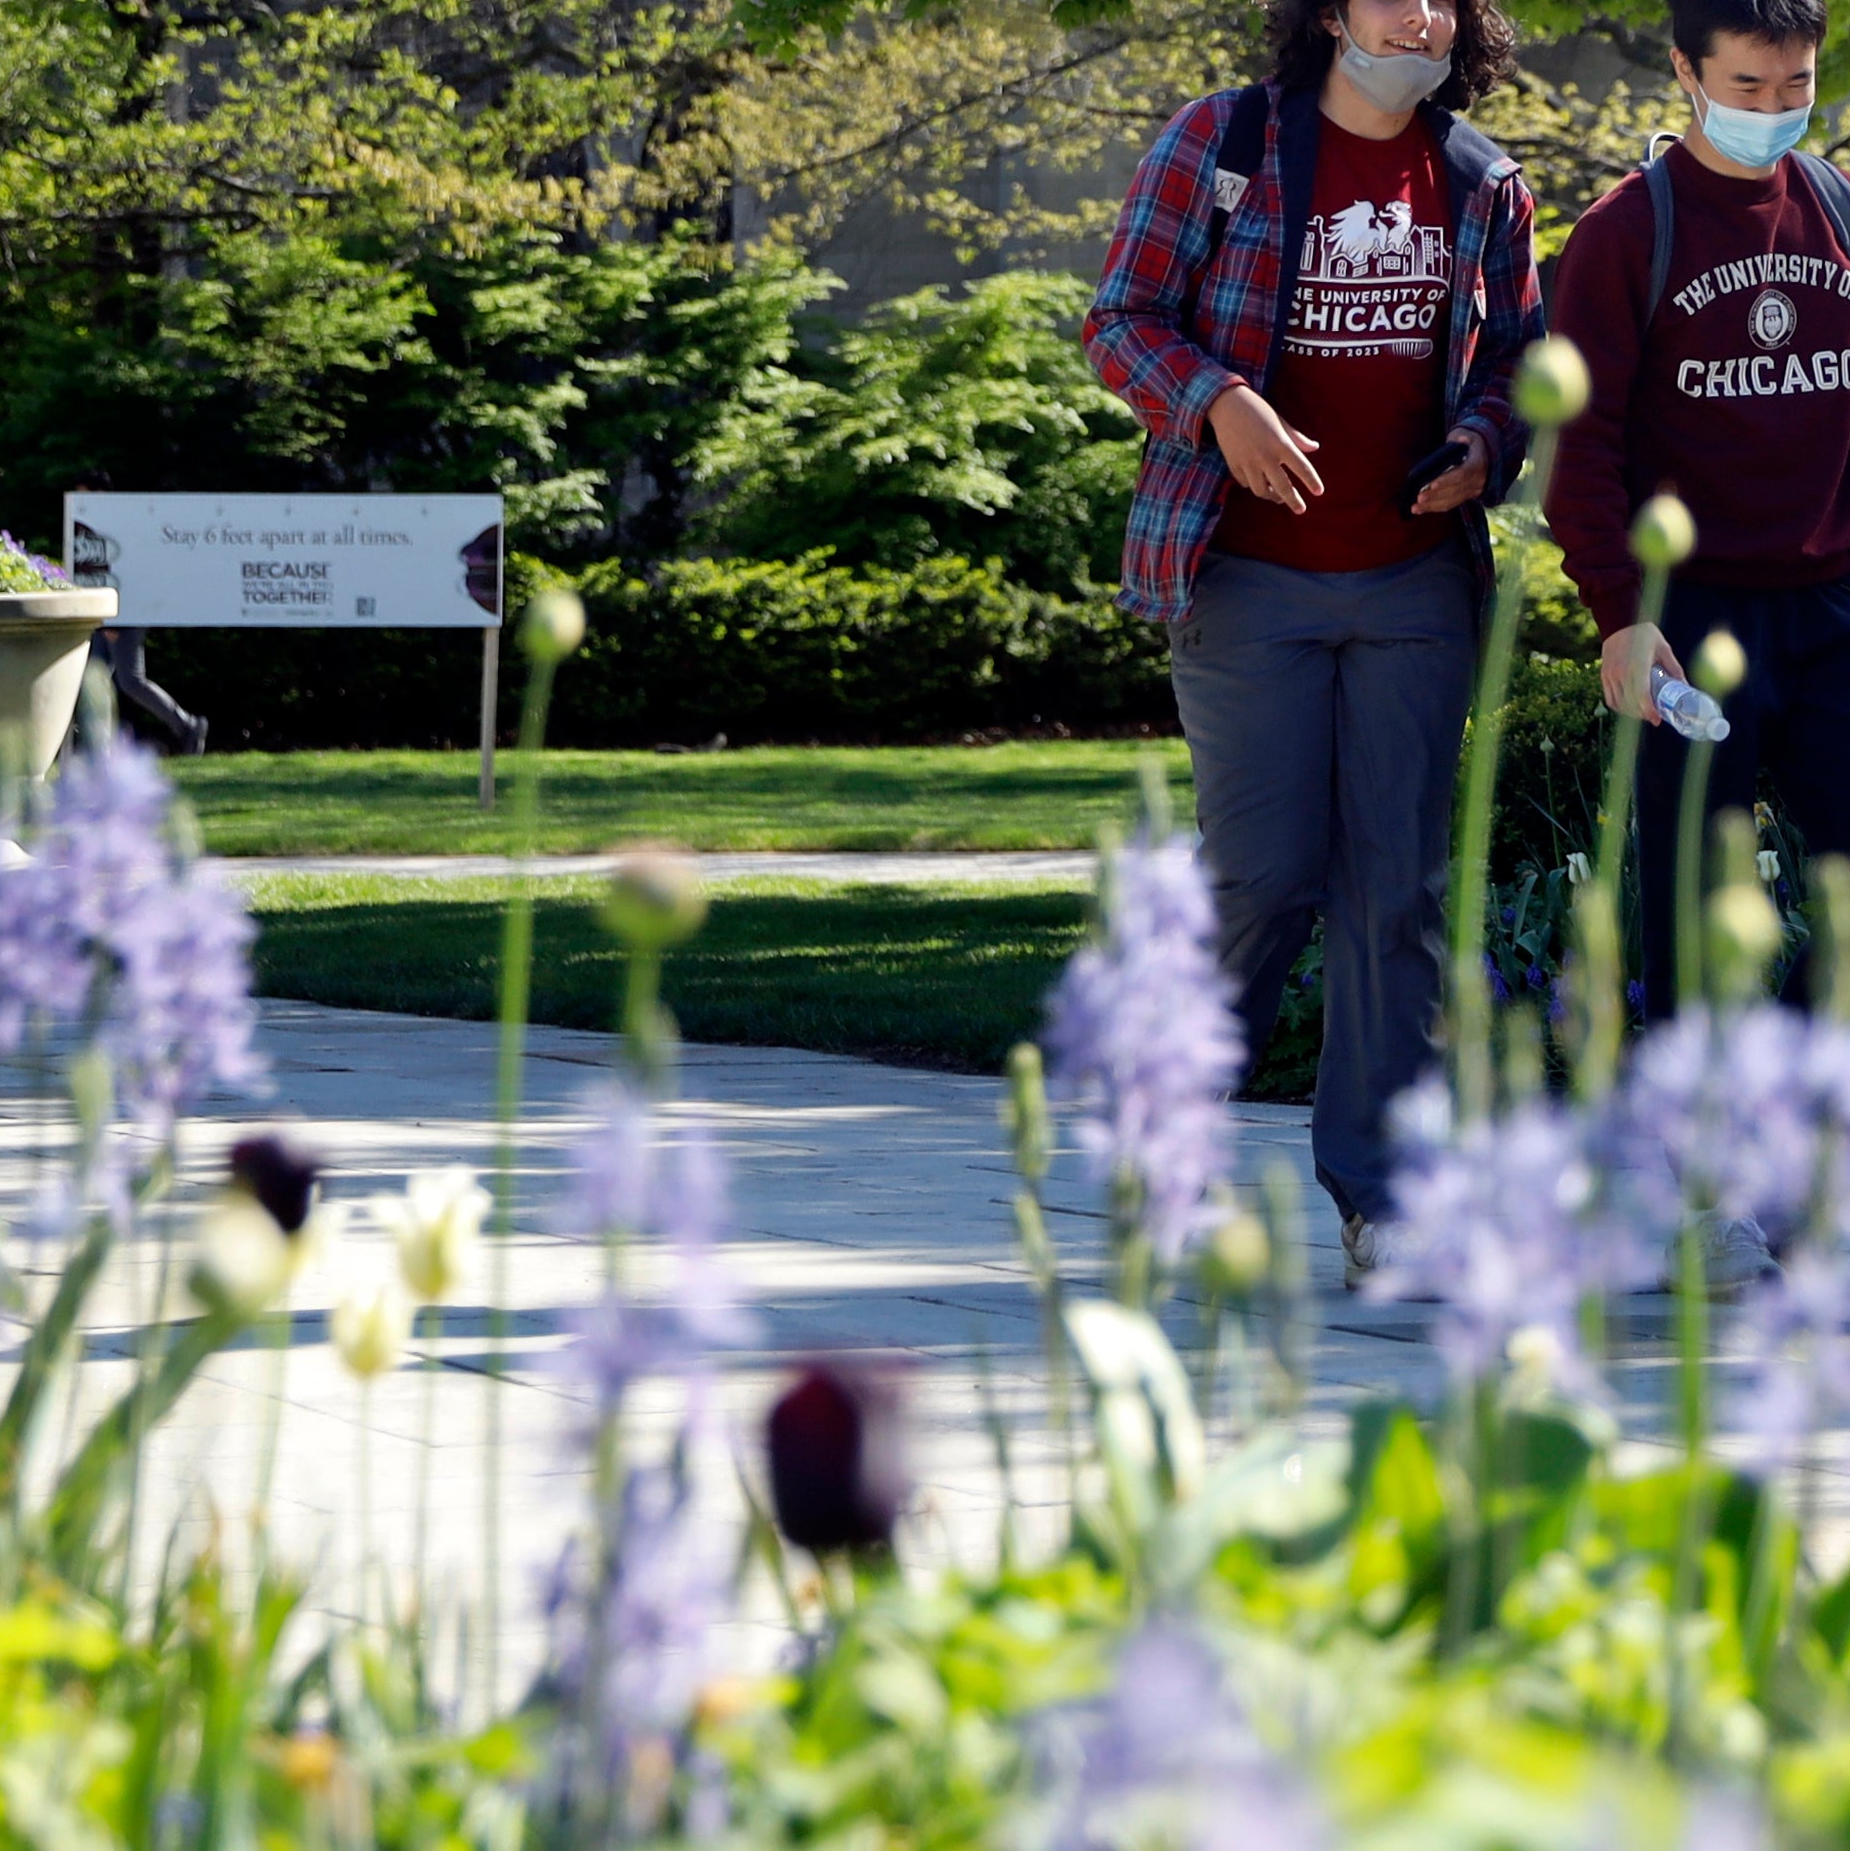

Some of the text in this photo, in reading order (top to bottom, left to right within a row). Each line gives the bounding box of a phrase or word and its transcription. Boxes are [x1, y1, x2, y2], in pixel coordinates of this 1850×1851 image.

[1673, 271, 1716, 316] THE
[1713, 253, 1838, 294] UNIVERSITY
[1294, 287, 1446, 304] HE UNIVERSITY OF
[1321, 348, 1339, 358] OF
[161, 524, 413, 550] Stay 6 feet apart at all times.
[241, 562, 332, 579] BECAUSE
